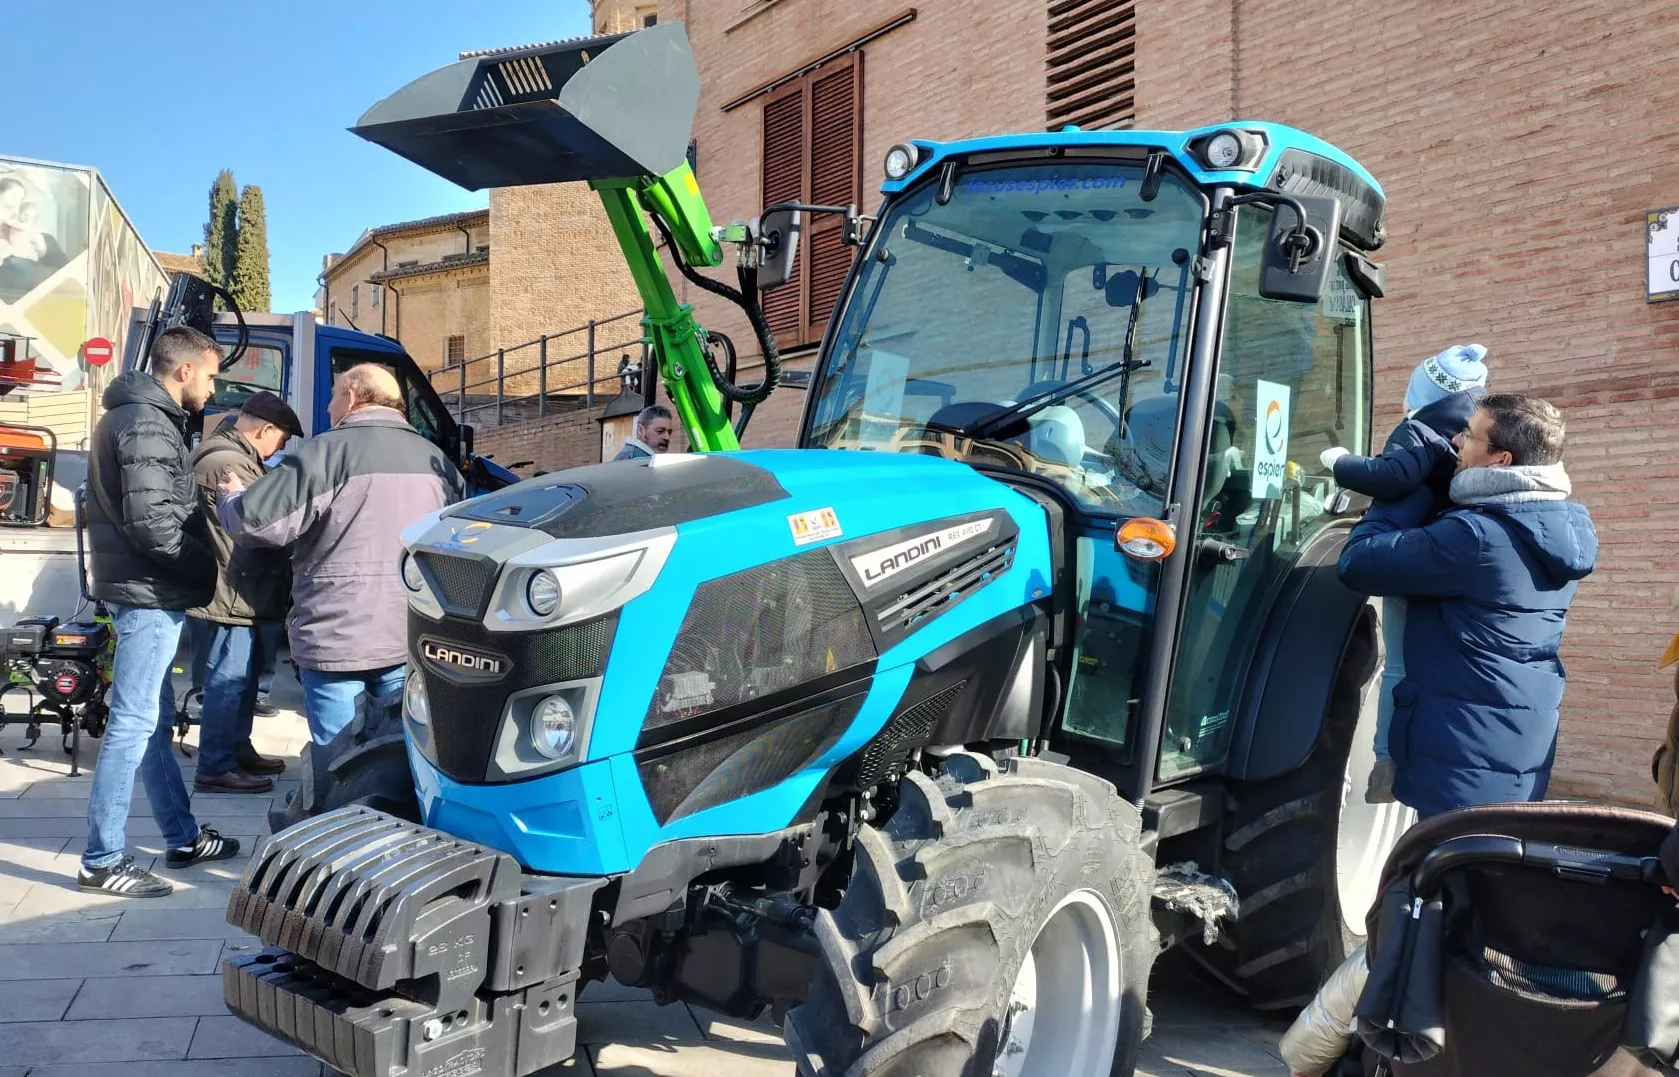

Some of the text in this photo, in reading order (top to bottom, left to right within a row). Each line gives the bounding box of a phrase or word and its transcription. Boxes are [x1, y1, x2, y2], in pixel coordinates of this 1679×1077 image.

[1258, 460, 1284, 481] espier
[864, 536, 942, 581] LANDINI
[425, 644, 500, 674] LANDINI
